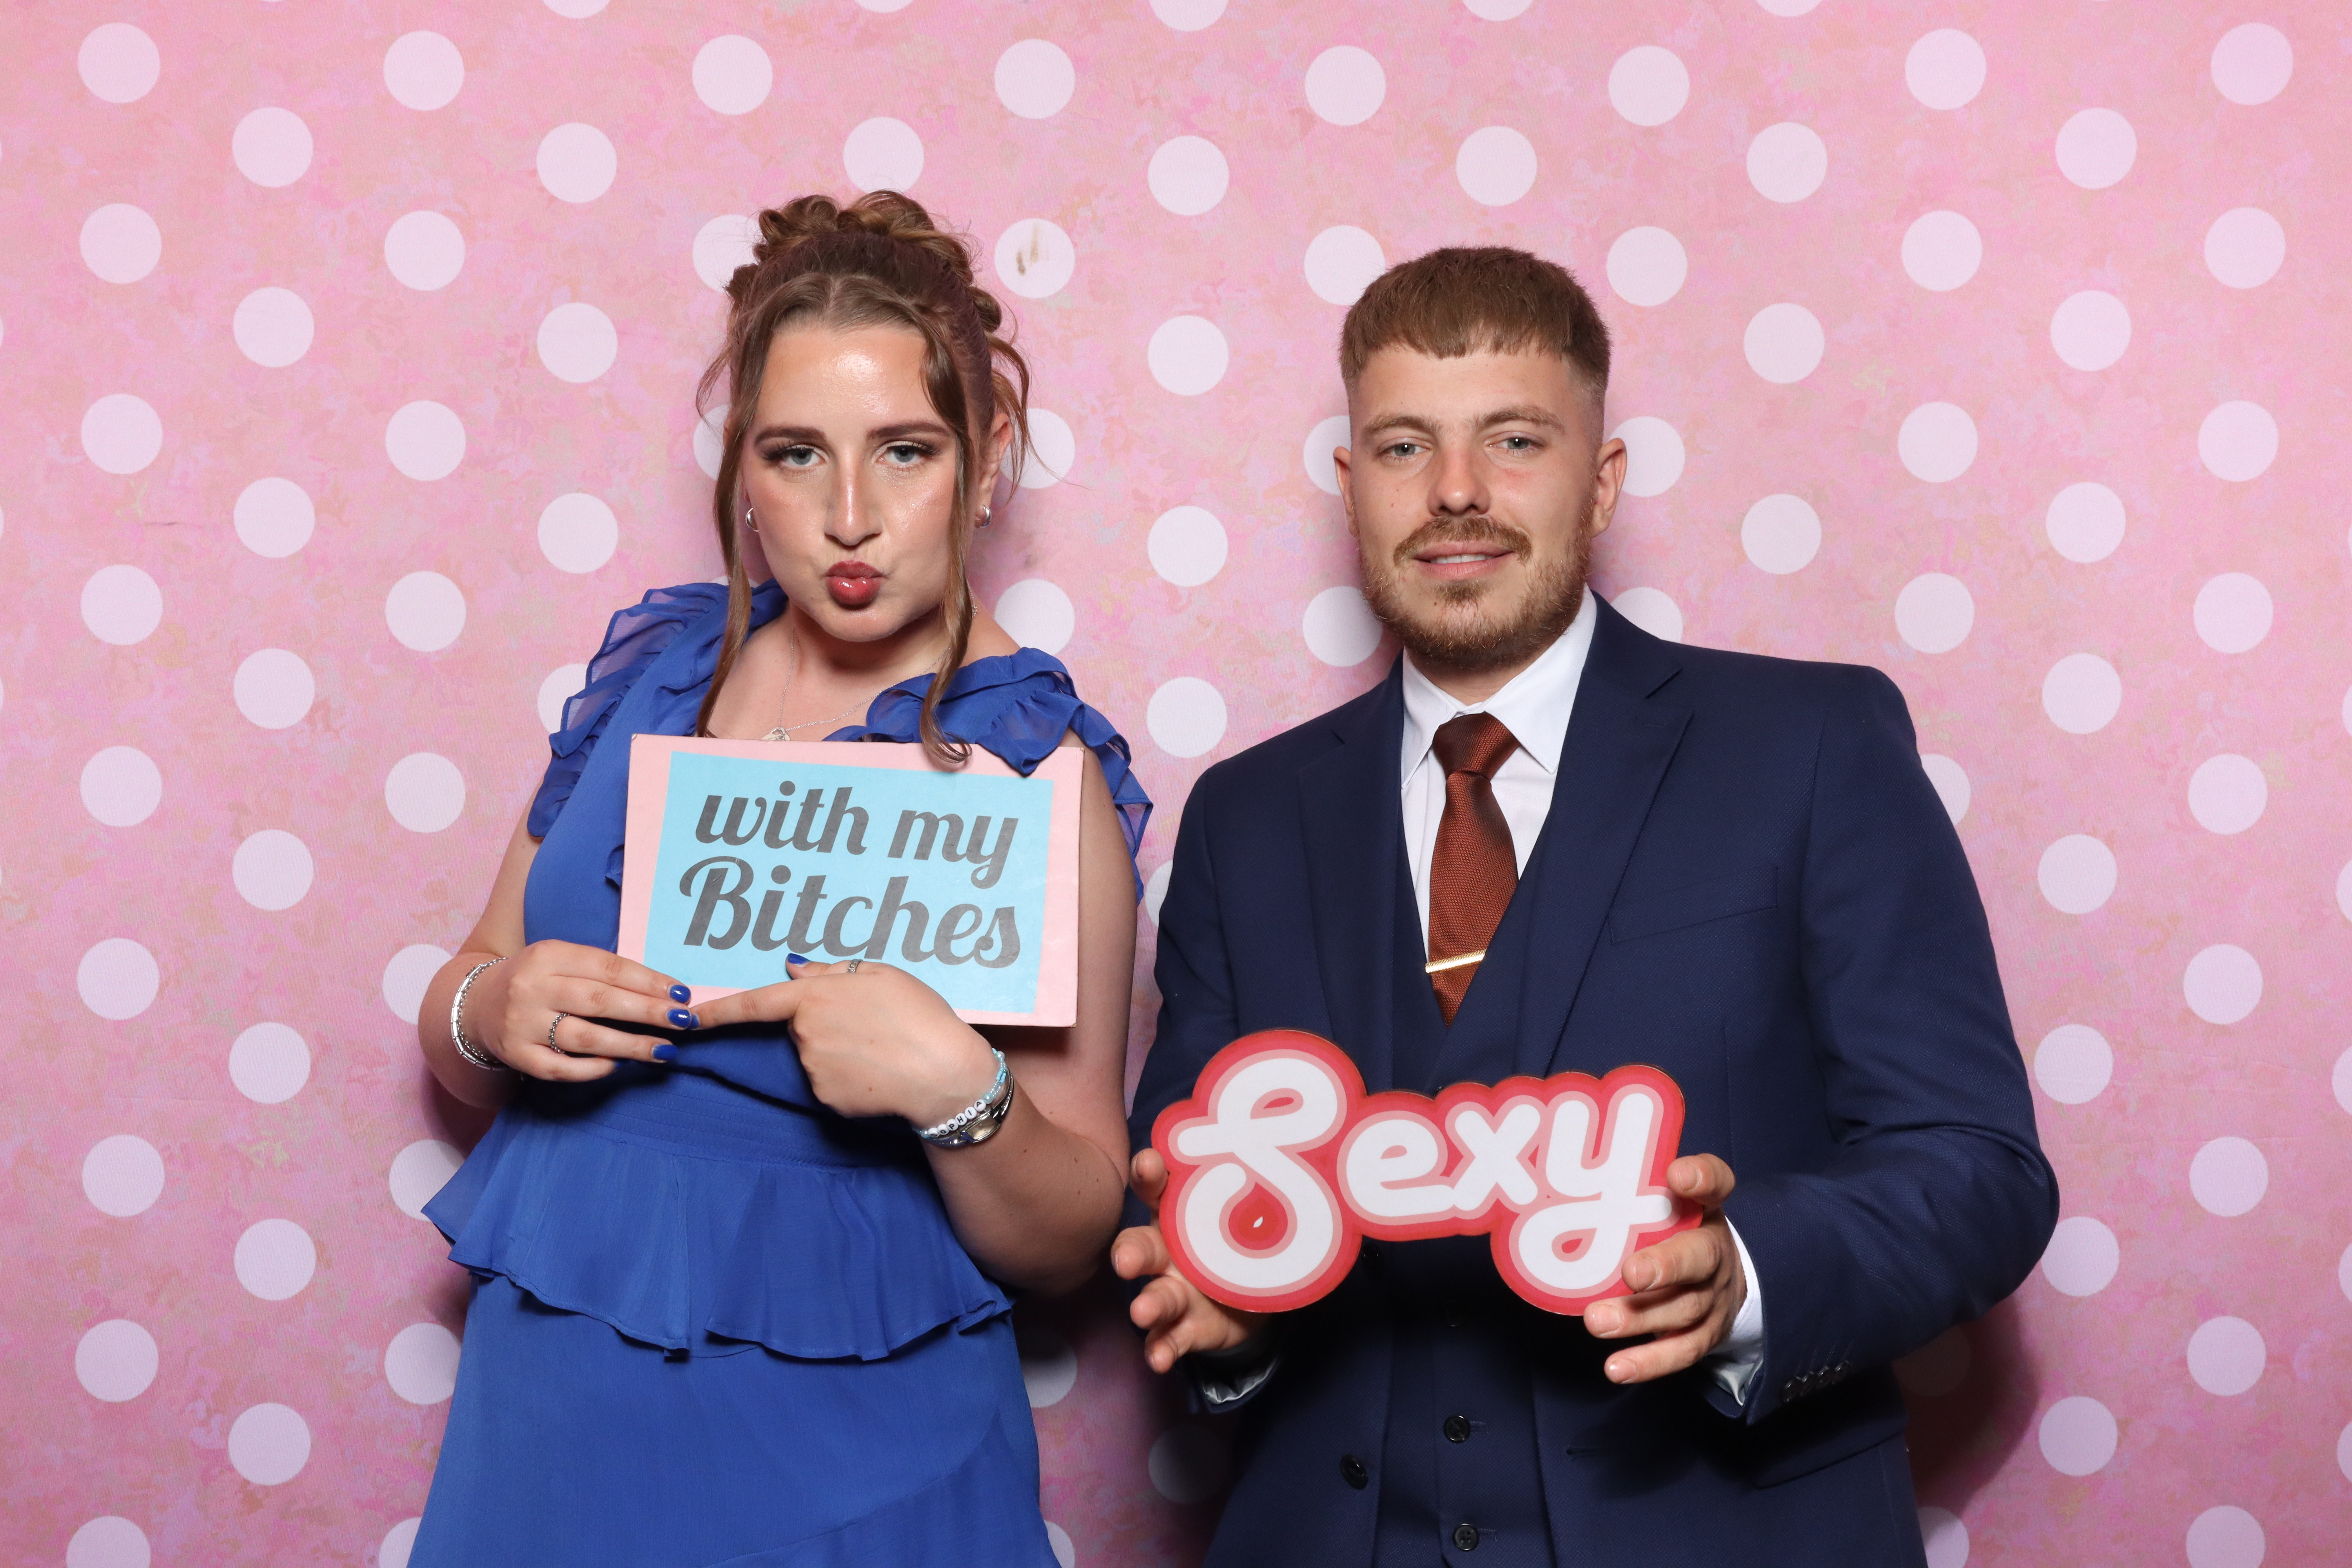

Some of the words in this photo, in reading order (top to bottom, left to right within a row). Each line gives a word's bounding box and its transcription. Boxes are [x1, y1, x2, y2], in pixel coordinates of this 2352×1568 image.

[695, 780, 869, 855] with
[887, 810, 1019, 889] my
[679, 856, 1020, 968] Bitches
[1175, 1057, 1673, 1290] Sexy
